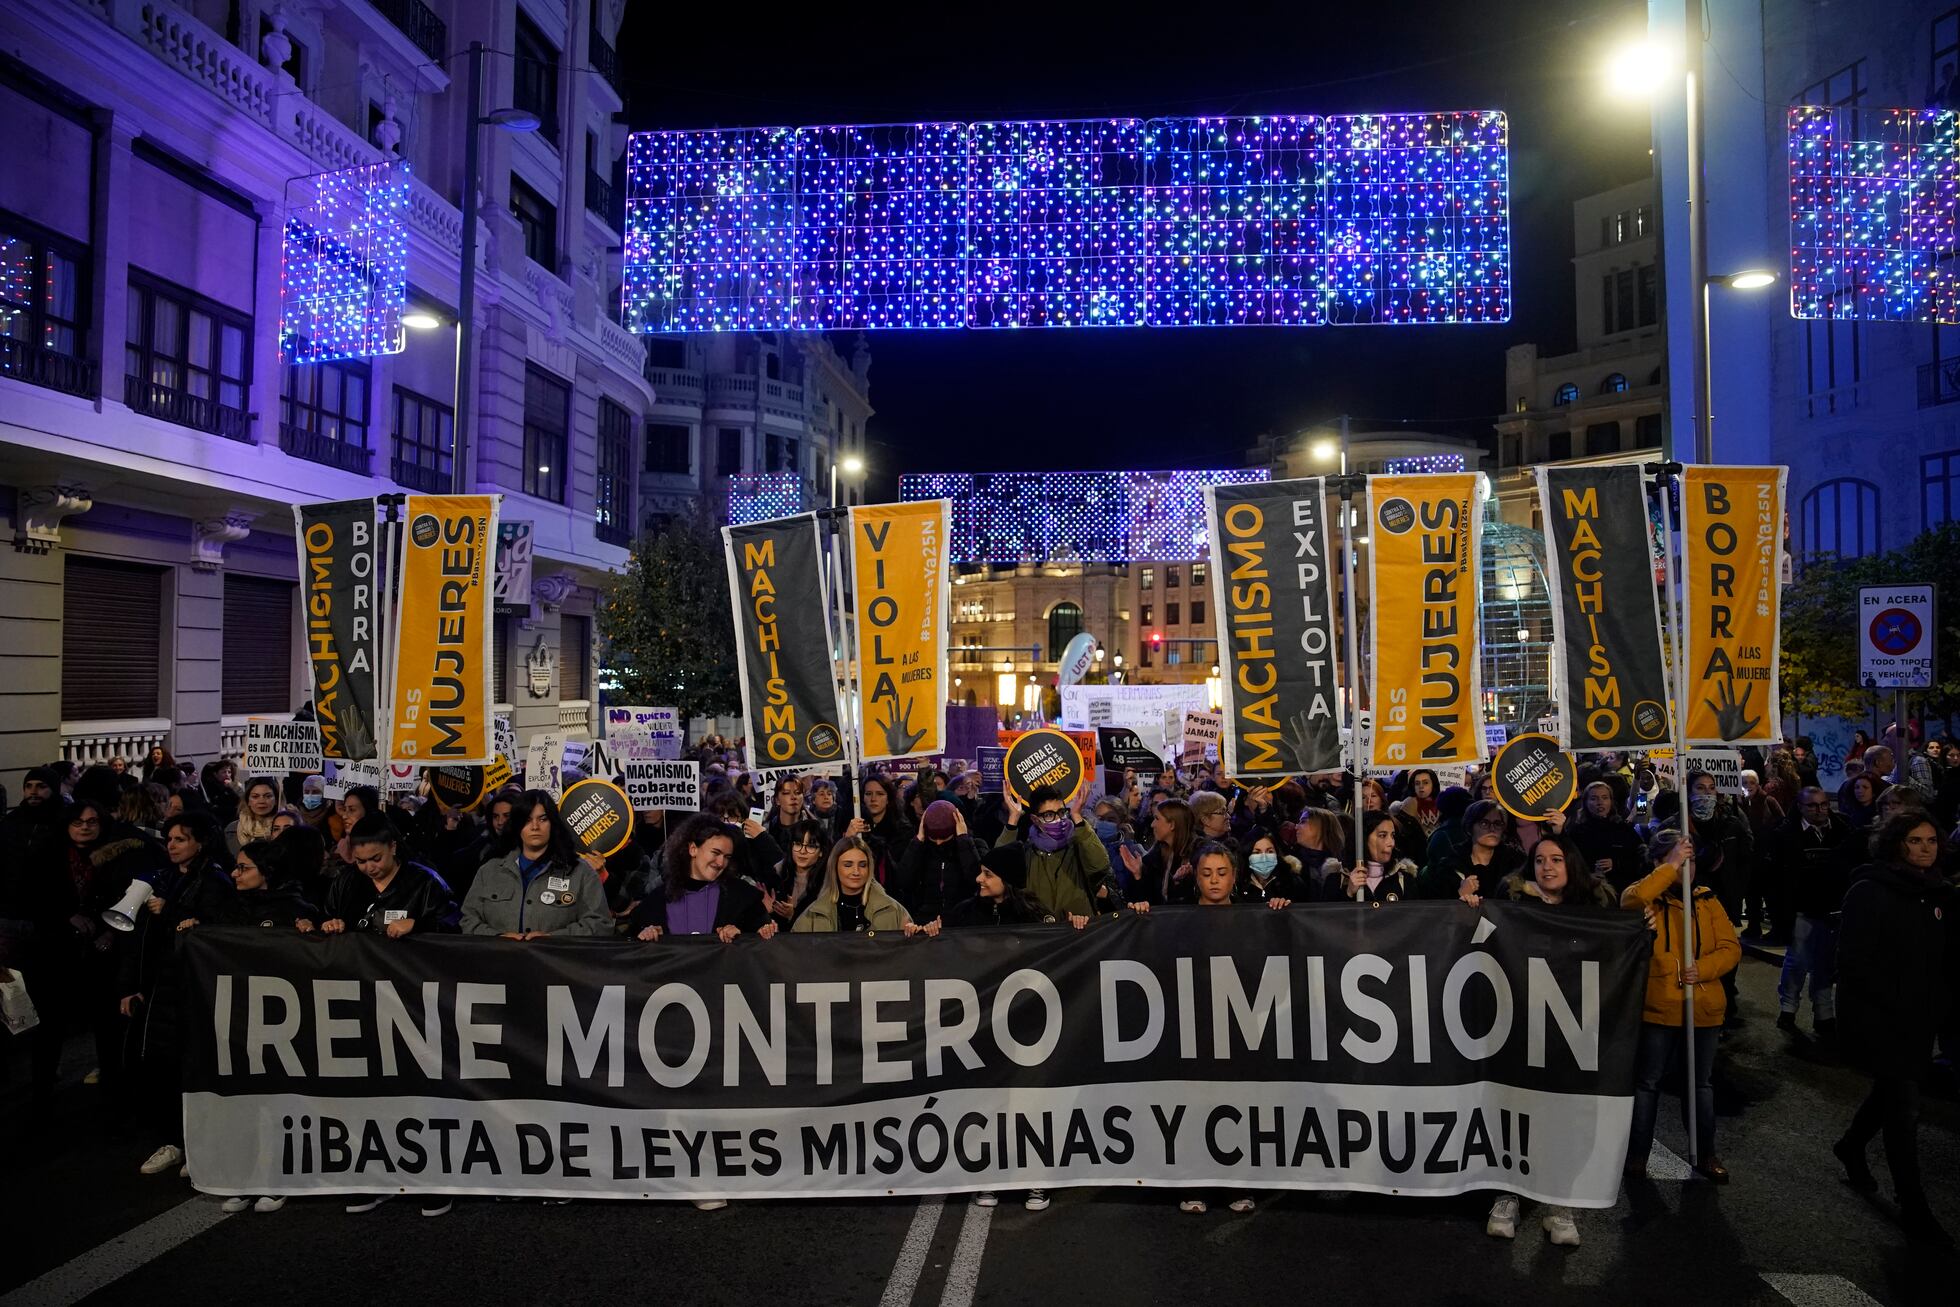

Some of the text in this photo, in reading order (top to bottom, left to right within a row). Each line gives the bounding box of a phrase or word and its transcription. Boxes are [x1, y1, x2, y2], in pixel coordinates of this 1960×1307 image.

[1460, 499, 1468, 573] #BastaYa25N
[1757, 484, 1773, 617] #BastaYa25N
[920, 520, 936, 641] #BastaYa25N
[1703, 483, 1737, 680] BORRA
[348, 521, 371, 673] BORRA
[1292, 500, 1331, 721] EXPLOTA
[1864, 595, 1927, 605] EN ACERA
[863, 521, 898, 703] VIOLA
[1562, 487, 1621, 741] MACHISMO
[305, 522, 343, 757] MACHISMO
[428, 515, 475, 756] MUJERES
[1225, 503, 1283, 771] MACHISMO
[1420, 498, 1460, 759] MUJERES
[744, 539, 797, 761] MACHISMO
[902, 651, 919, 666] A LAS
[1072, 652, 1089, 675] UGT
[1738, 647, 1761, 659] A LAS
[901, 668, 932, 684] MUJERES
[400, 688, 422, 756] a las
[610, 709, 631, 723] NO
[1187, 714, 1219, 727] Pegar,
[1383, 687, 1407, 760] a las
[1540, 721, 1553, 732] TÚ
[249, 724, 260, 738] EL
[1110, 736, 1141, 748] 1.16
[1185, 727, 1217, 739] JAMÁS!
[248, 741, 319, 754] es un CRIMEN
[1016, 749, 1047, 774] CONTRA
[1044, 743, 1057, 754] EL
[1113, 755, 1125, 764] 48
[248, 756, 319, 769] CONTRA TODOS
[362, 764, 380, 778] impo
[1023, 757, 1056, 784] BORRADO
[1505, 748, 1547, 783] CONTRA EL
[1686, 758, 1738, 772] DOS CONTRA
[326, 776, 338, 787] sale
[339, 777, 344, 788] el
[438, 773, 471, 795] MUJERES
[628, 782, 696, 793] cobarde
[1513, 762, 1547, 794] BORRADO
[1522, 768, 1564, 806] MUJERES
[1715, 775, 1738, 787] TRATO
[566, 792, 604, 826] CONTRA EL
[630, 794, 697, 807] terrorismo.
[573, 807, 605, 835] BORRADO
[580, 809, 620, 847] MUJERES
[213, 915, 1600, 1088] IRENE MONTERO DIMISIÓN
[282, 1096, 1531, 1179] ¡¡BASTA DE LEYES MISÓGINAS Y CHAPUZA!!
